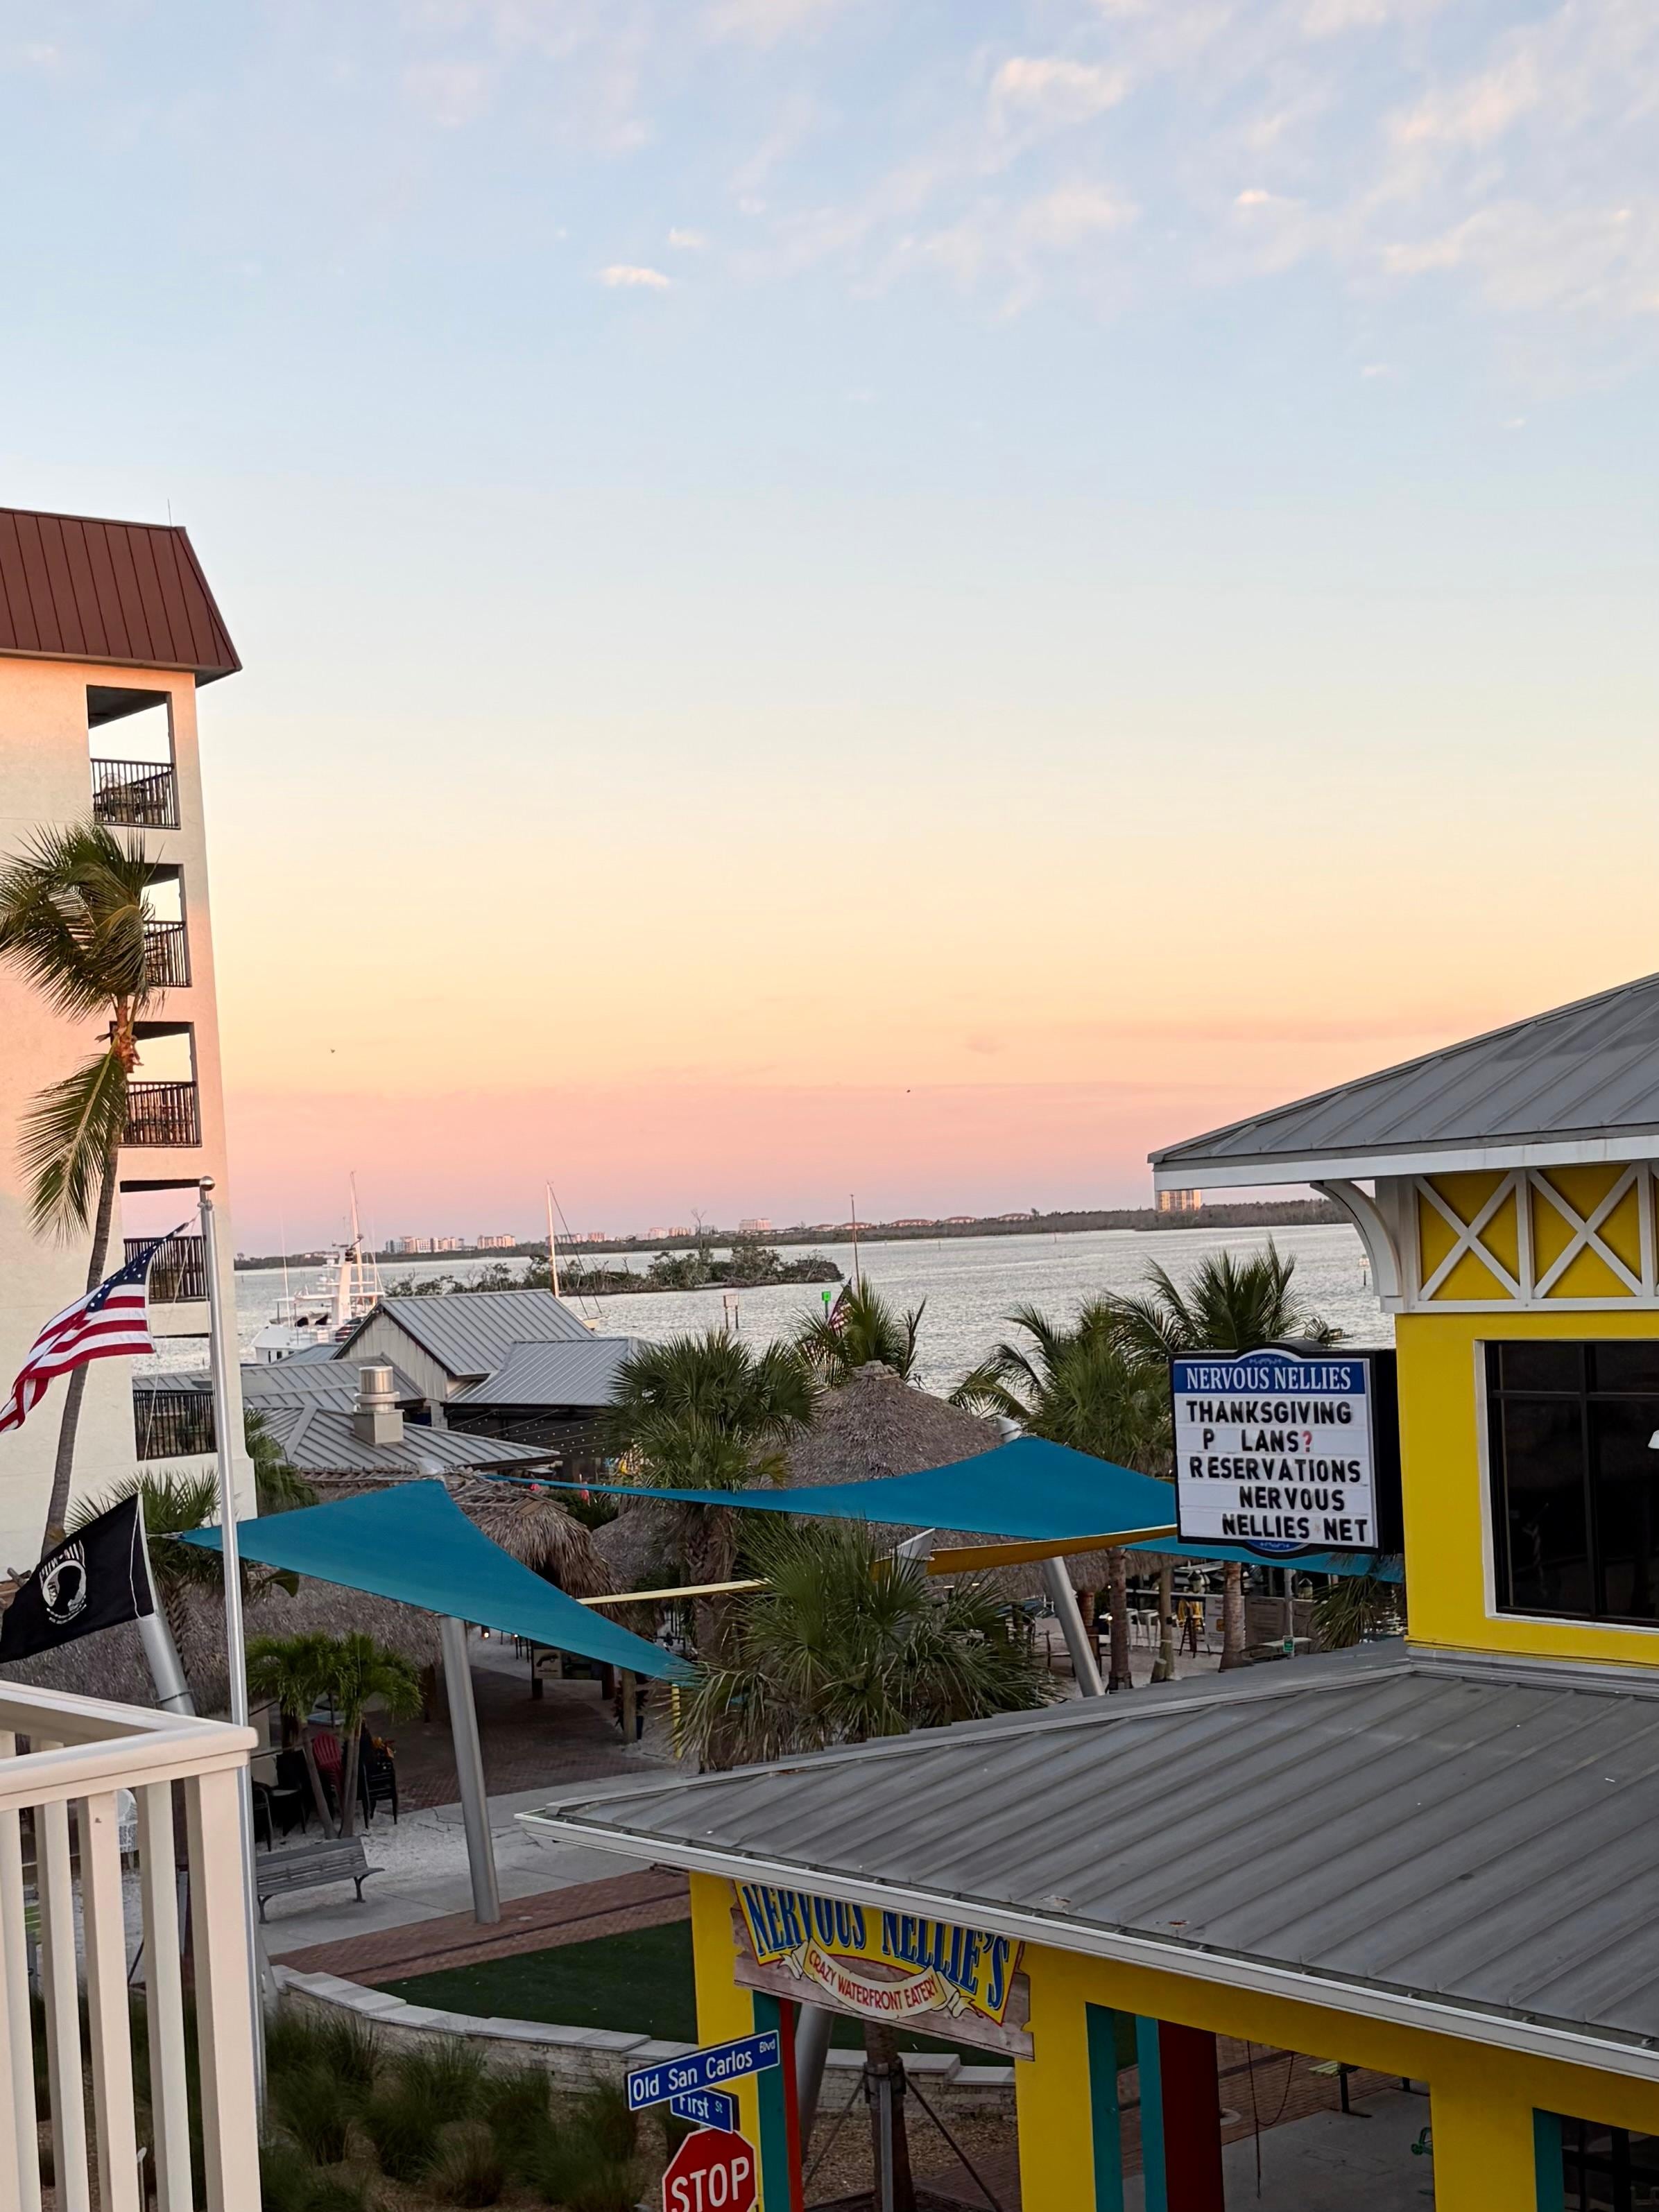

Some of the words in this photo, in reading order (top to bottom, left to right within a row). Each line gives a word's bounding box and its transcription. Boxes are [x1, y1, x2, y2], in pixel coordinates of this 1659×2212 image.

[1187, 1367, 1270, 1390] NERVOUS
[1274, 1367, 1351, 1390] NELLIES
[1186, 1400, 1352, 1424] THANKSGIVING
[1189, 1456, 1361, 1483] RESERVATIONS
[1239, 1486, 1345, 1512] NERVOUS
[1222, 1514, 1309, 1539] NELLIES
[1323, 1518, 1368, 1542] NET
[742, 1884, 866, 1957] NERVOUS
[882, 1911, 1010, 2011] NELLIE'S
[809, 1950, 836, 1986] CRAZY
[838, 1974, 903, 2011] WATERFRONT
[904, 1976, 938, 2008] EATERY
[633, 2073, 659, 2102] Old
[668, 2067, 698, 2091] San
[705, 2050, 753, 2080] Carlos
[759, 2039, 776, 2054] Blvd
[715, 2100, 723, 2114] St
[671, 2156, 750, 2212] STOP
